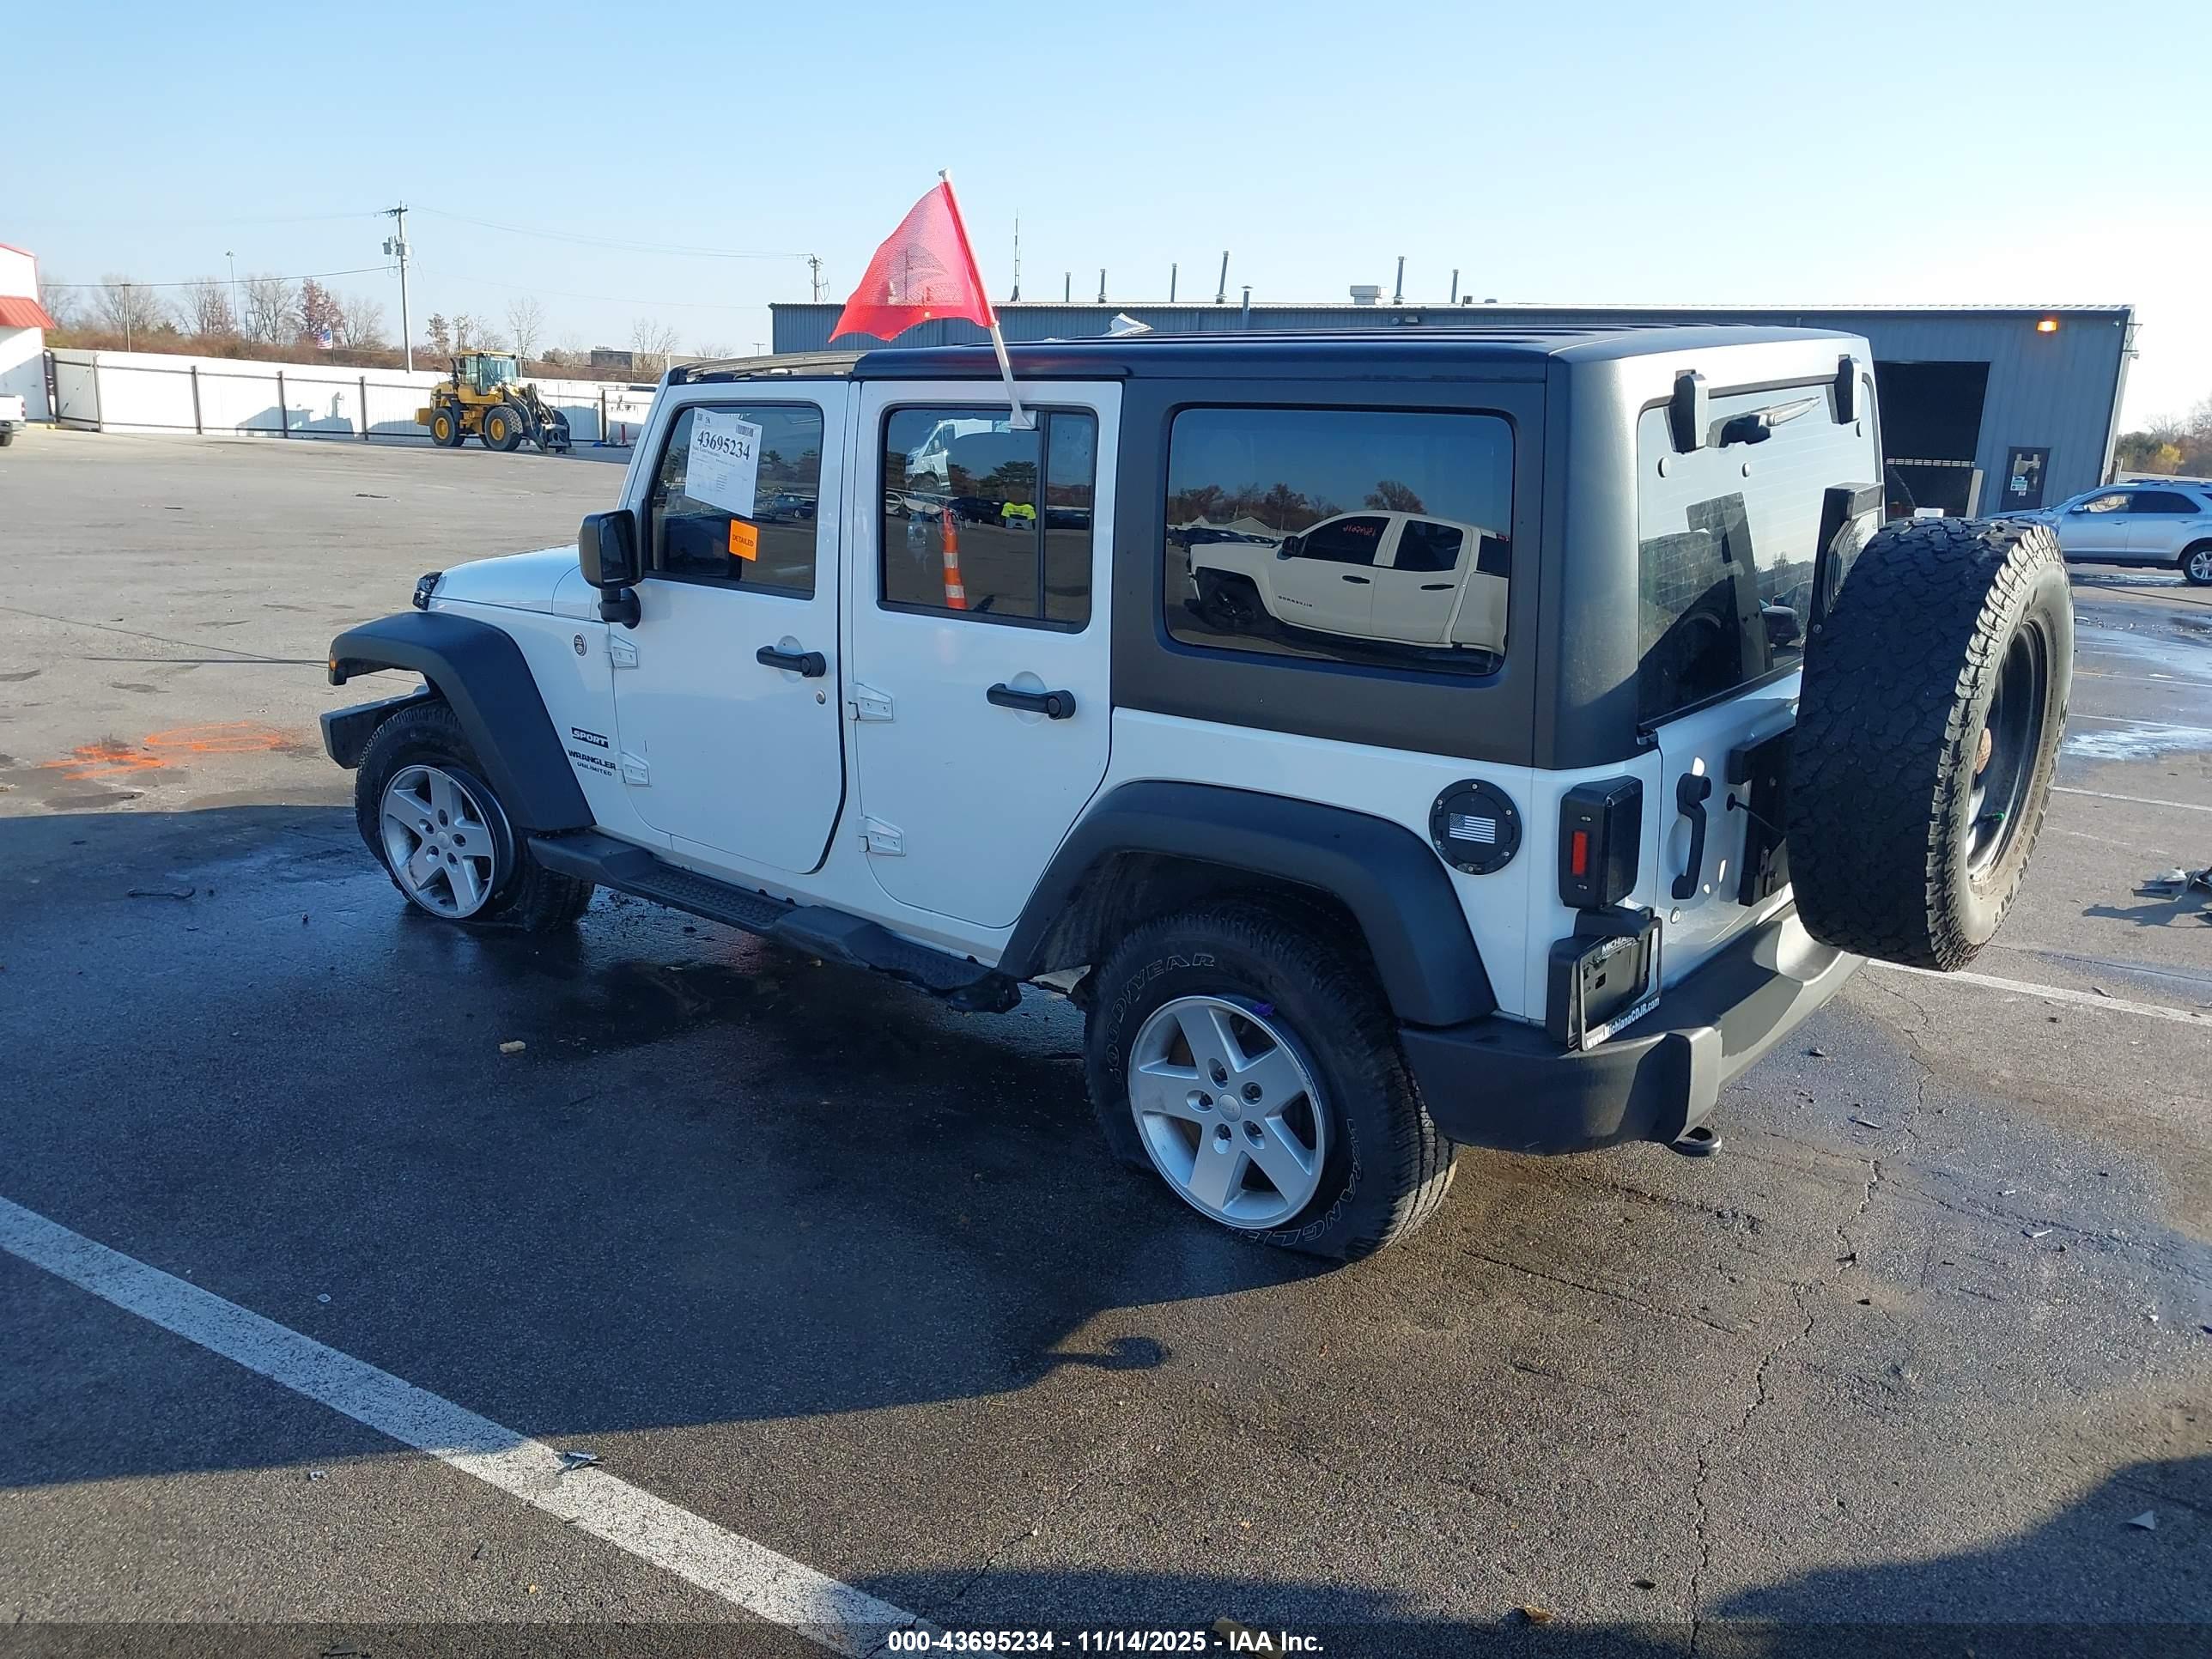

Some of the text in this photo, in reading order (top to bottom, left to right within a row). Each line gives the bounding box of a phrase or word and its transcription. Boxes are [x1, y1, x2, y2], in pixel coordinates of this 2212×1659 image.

[697, 430, 750, 461] 43695234
[732, 534, 754, 547] DETAILED
[573, 730, 606, 745] SPORT
[568, 749, 617, 770] WRANGLER
[577, 762, 612, 776] UNLIMITED
[1106, 952, 1215, 1092] GOODYEAR
